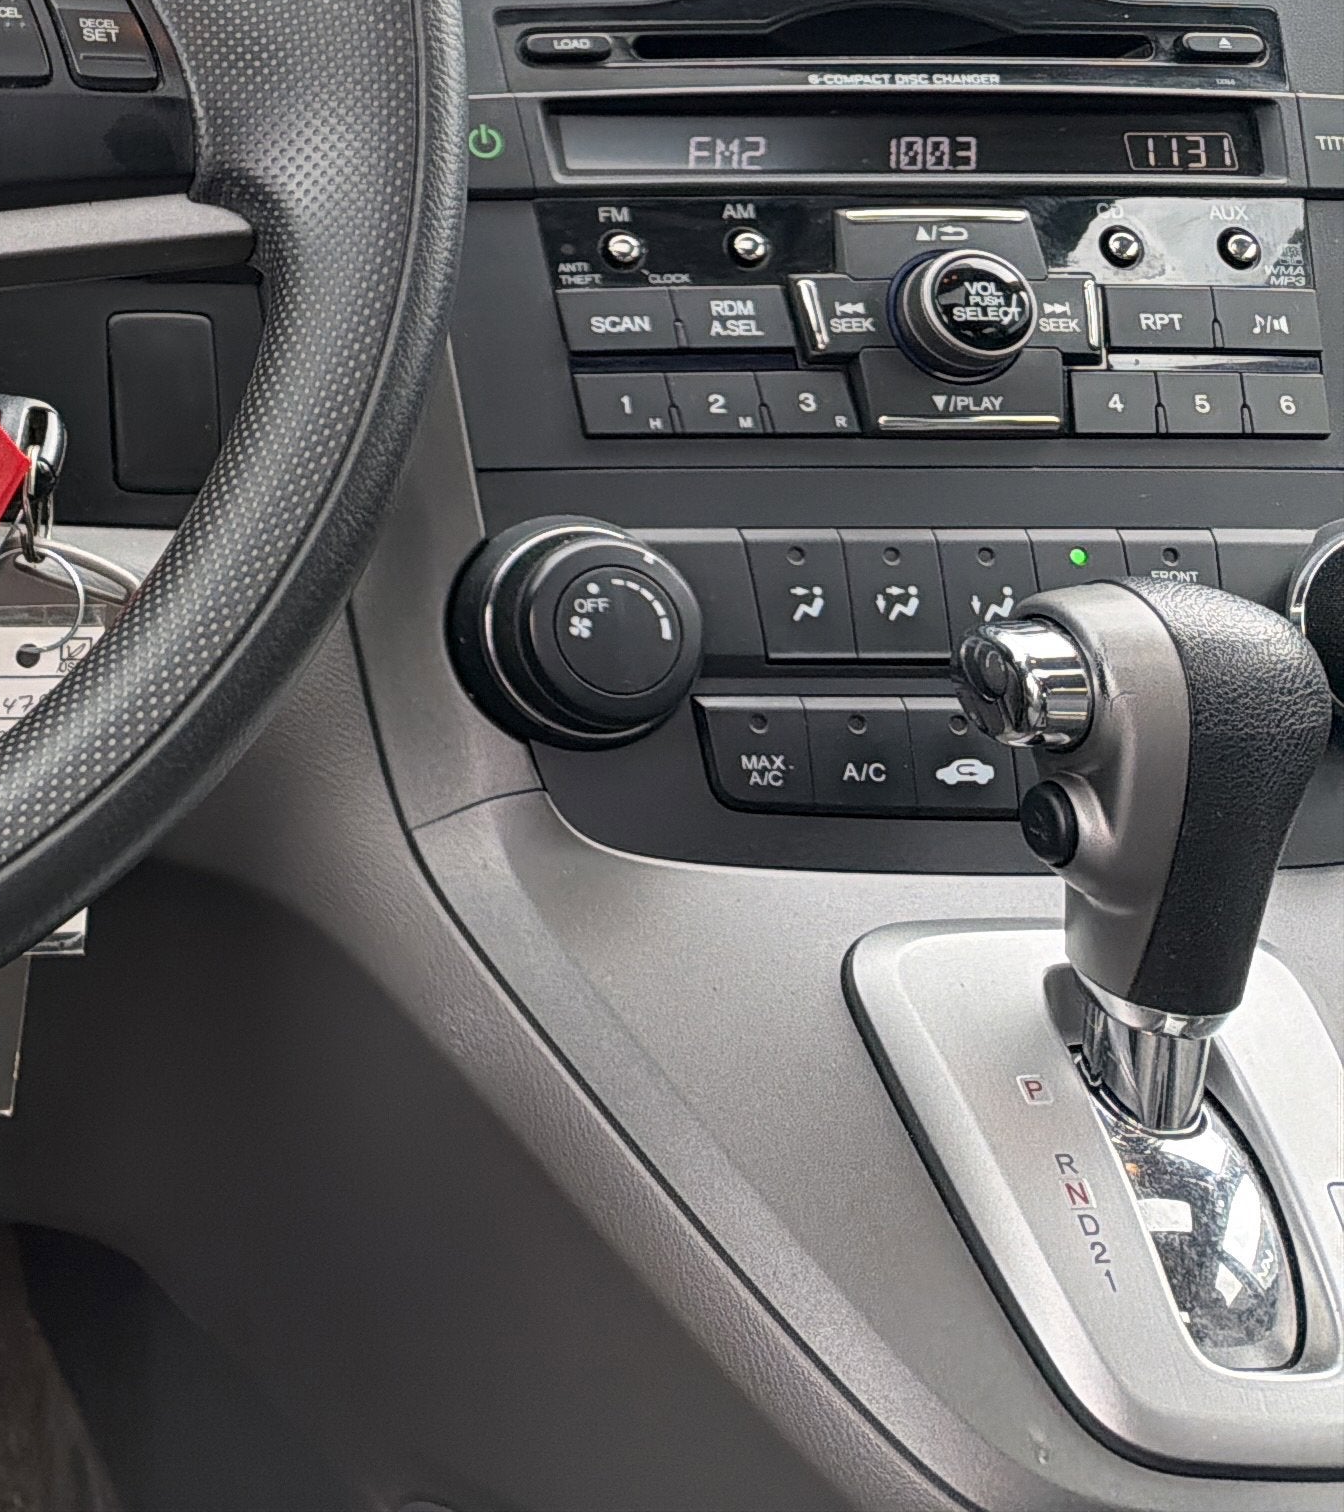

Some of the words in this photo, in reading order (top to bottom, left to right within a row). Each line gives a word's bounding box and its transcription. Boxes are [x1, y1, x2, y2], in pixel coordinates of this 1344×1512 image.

[79, 18, 120, 28] DECEL
[83, 28, 120, 42] SET
[553, 39, 591, 50] LOAD
[808, 74, 891, 85] 6-COMPACT
[895, 74, 930, 85] DISC
[932, 74, 1000, 85] CHANGER
[1315, 136, 1344, 150] TIT
[688, 136, 767, 170] FM2
[598, 207, 630, 222] FM
[722, 203, 756, 220] AM
[1096, 202, 1124, 219] CD
[1209, 205, 1249, 221] AUX
[1264, 265, 1305, 275] WMA
[559, 274, 602, 285] THEFT
[648, 273, 691, 284] CLOCK
[1270, 276, 1305, 286] MP3
[964, 282, 1003, 295] VOL
[710, 300, 755, 316] RDM
[969, 296, 1005, 306] PUSH
[952, 307, 1022, 322] SELECT
[1139, 313, 1183, 331] RPT
[590, 316, 652, 333] SCAN
[829, 317, 876, 333] SEEK
[1039, 318, 1081, 332] SEEK
[620, 395, 633, 414] 1
[707, 394, 728, 414] 2
[798, 392, 817, 412] 3
[1107, 394, 1124, 413] 4
[1194, 394, 1211, 413] 5
[1279, 395, 1296, 415] 6
[648, 417, 663, 430] H
[834, 415, 848, 428] R
[574, 598, 609, 614] OFF
[741, 754, 786, 770] MAX
[749, 771, 784, 787] A/C
[842, 762, 887, 783] A/C
[1024, 1080, 1043, 1101] P
[1054, 1153, 1079, 1174] R
[1064, 1181, 1090, 1206] N
[1077, 1214, 1100, 1237] D
[1090, 1241, 1111, 1265] 2
[1104, 1270, 1117, 1293] 1
